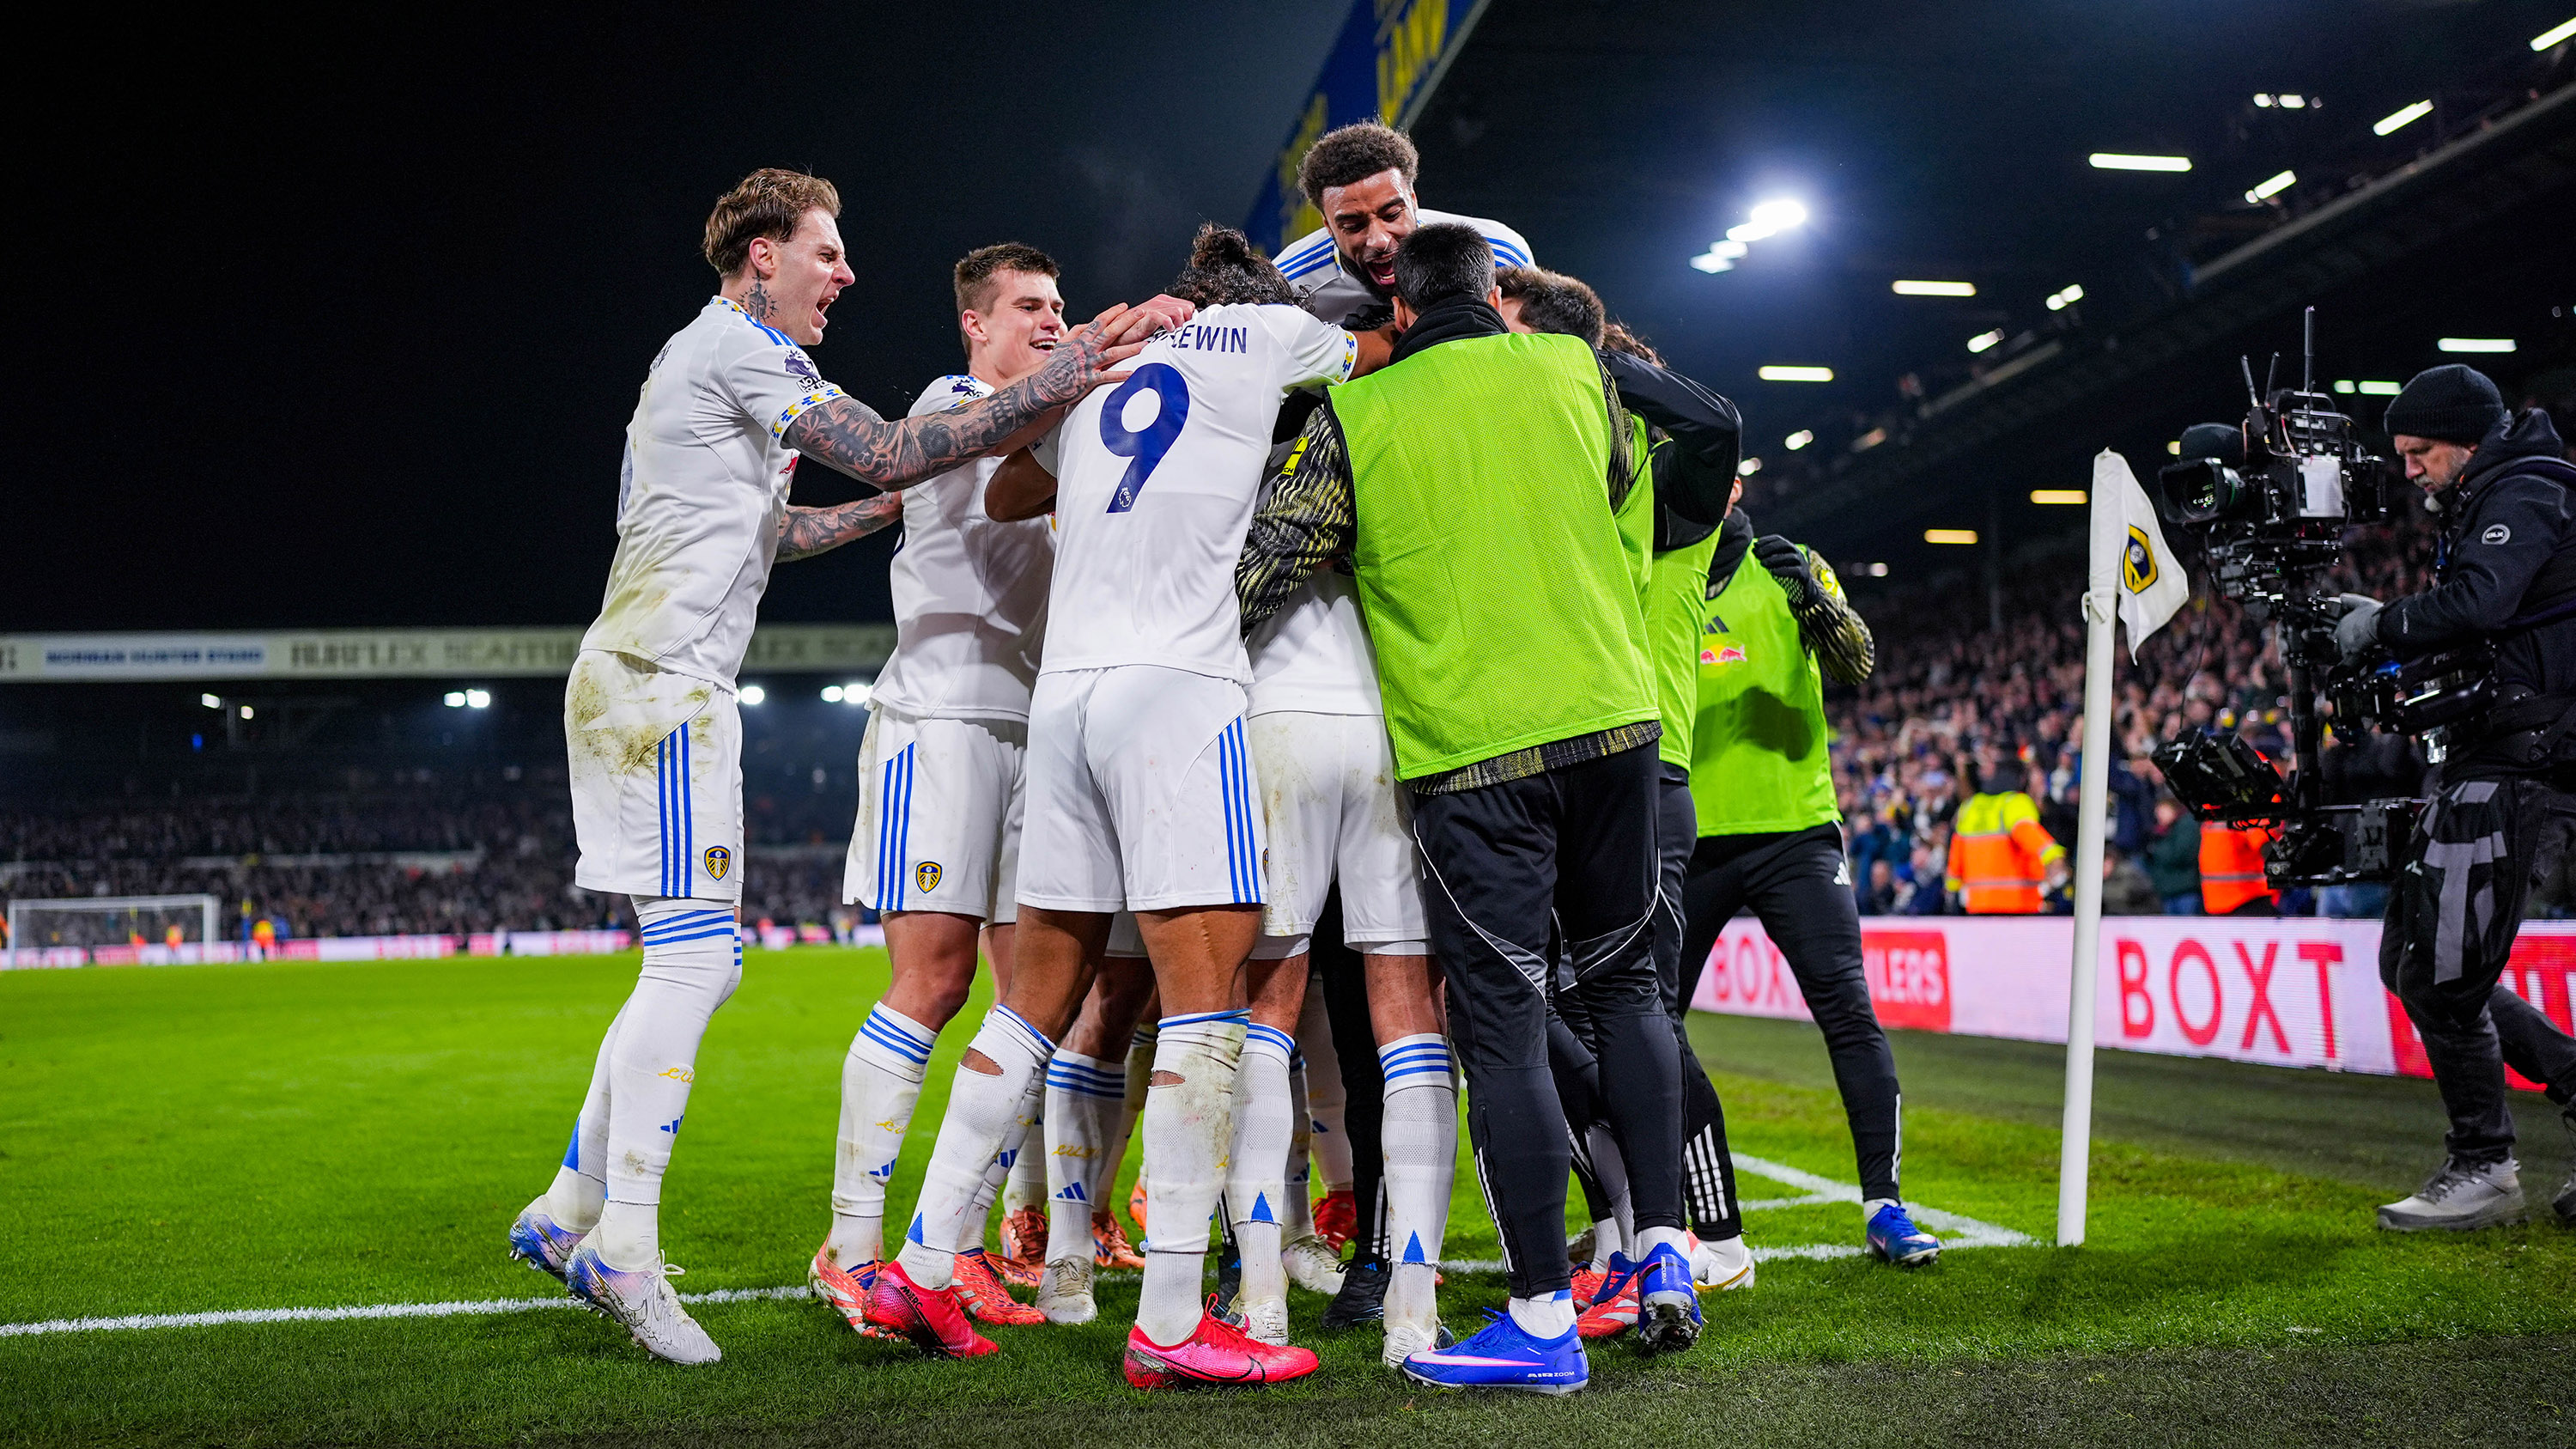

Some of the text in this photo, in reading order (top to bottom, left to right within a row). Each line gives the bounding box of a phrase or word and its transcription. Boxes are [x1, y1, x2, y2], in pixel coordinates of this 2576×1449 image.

[1100, 362, 1190, 514] 9
[1713, 936, 1808, 1009] BOX
[2116, 937, 2344, 1059] BOXT
